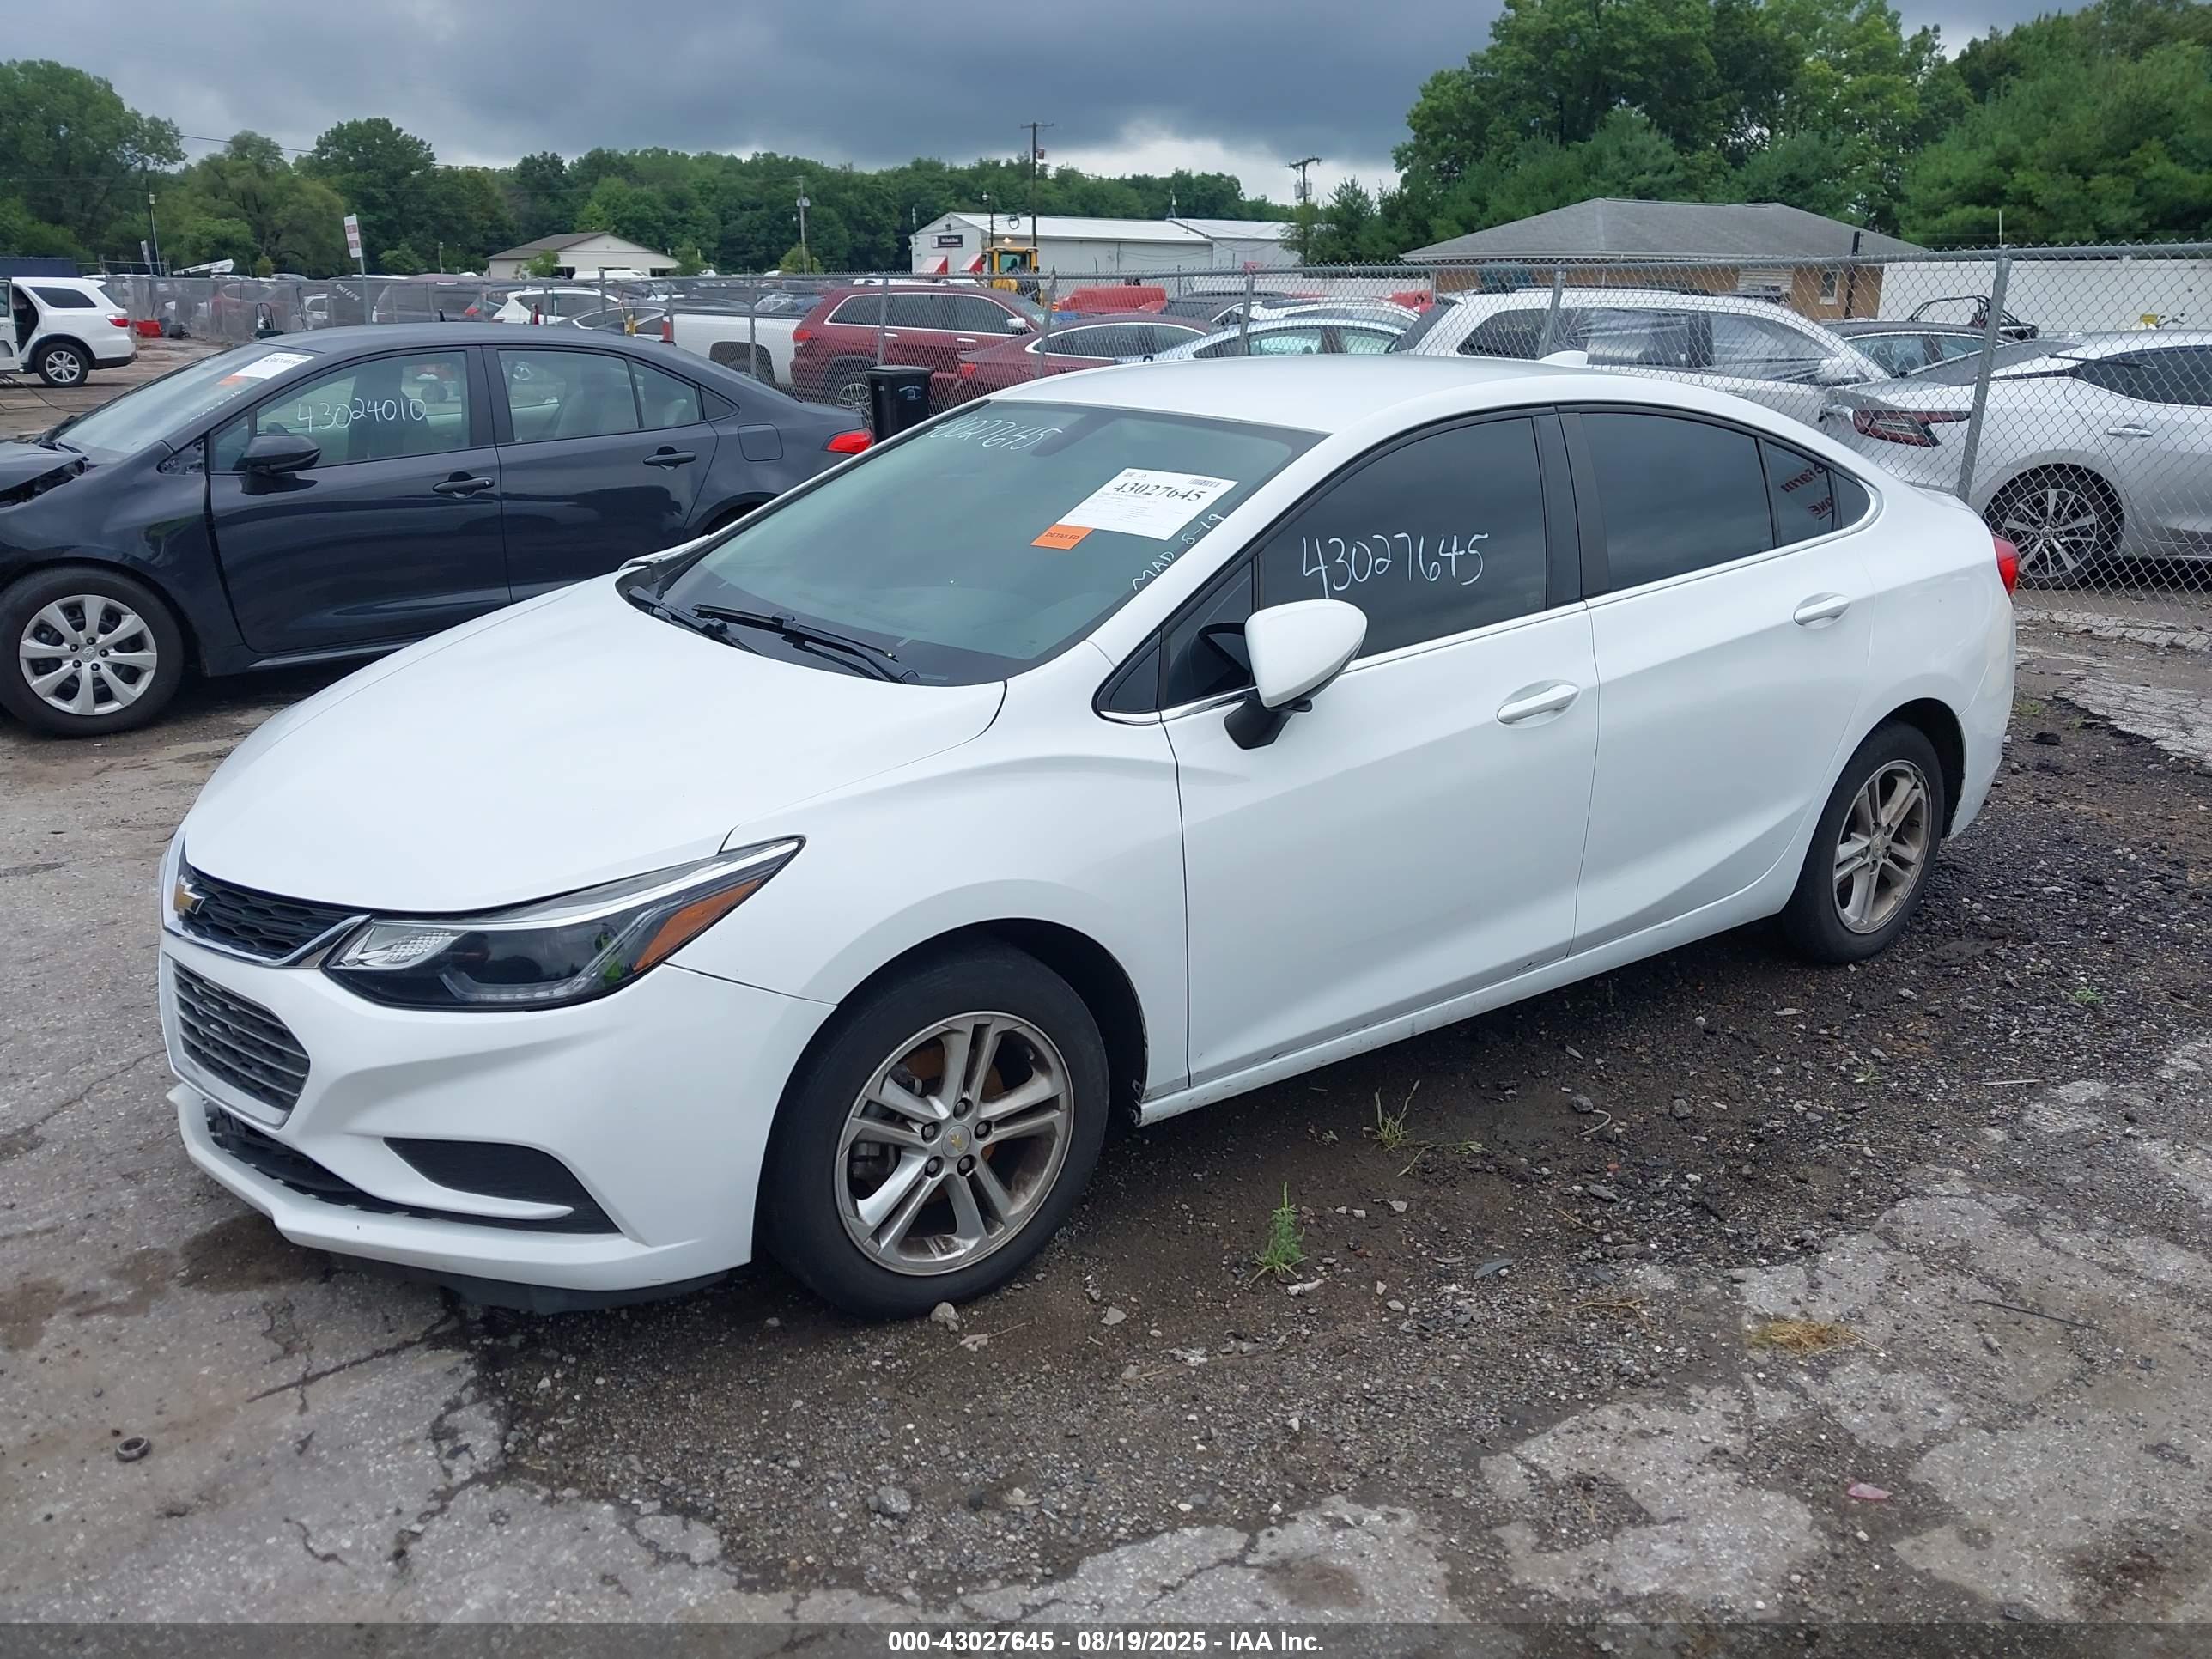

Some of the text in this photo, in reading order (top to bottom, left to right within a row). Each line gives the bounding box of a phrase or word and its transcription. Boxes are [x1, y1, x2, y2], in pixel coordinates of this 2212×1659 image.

[297, 398, 426, 432] 43024010
[1113, 482, 1207, 501] 43027645
[1045, 532, 1079, 540] DETAILED
[1132, 514, 1225, 591] MAD 8-19
[1302, 532, 1490, 599] 43027645
